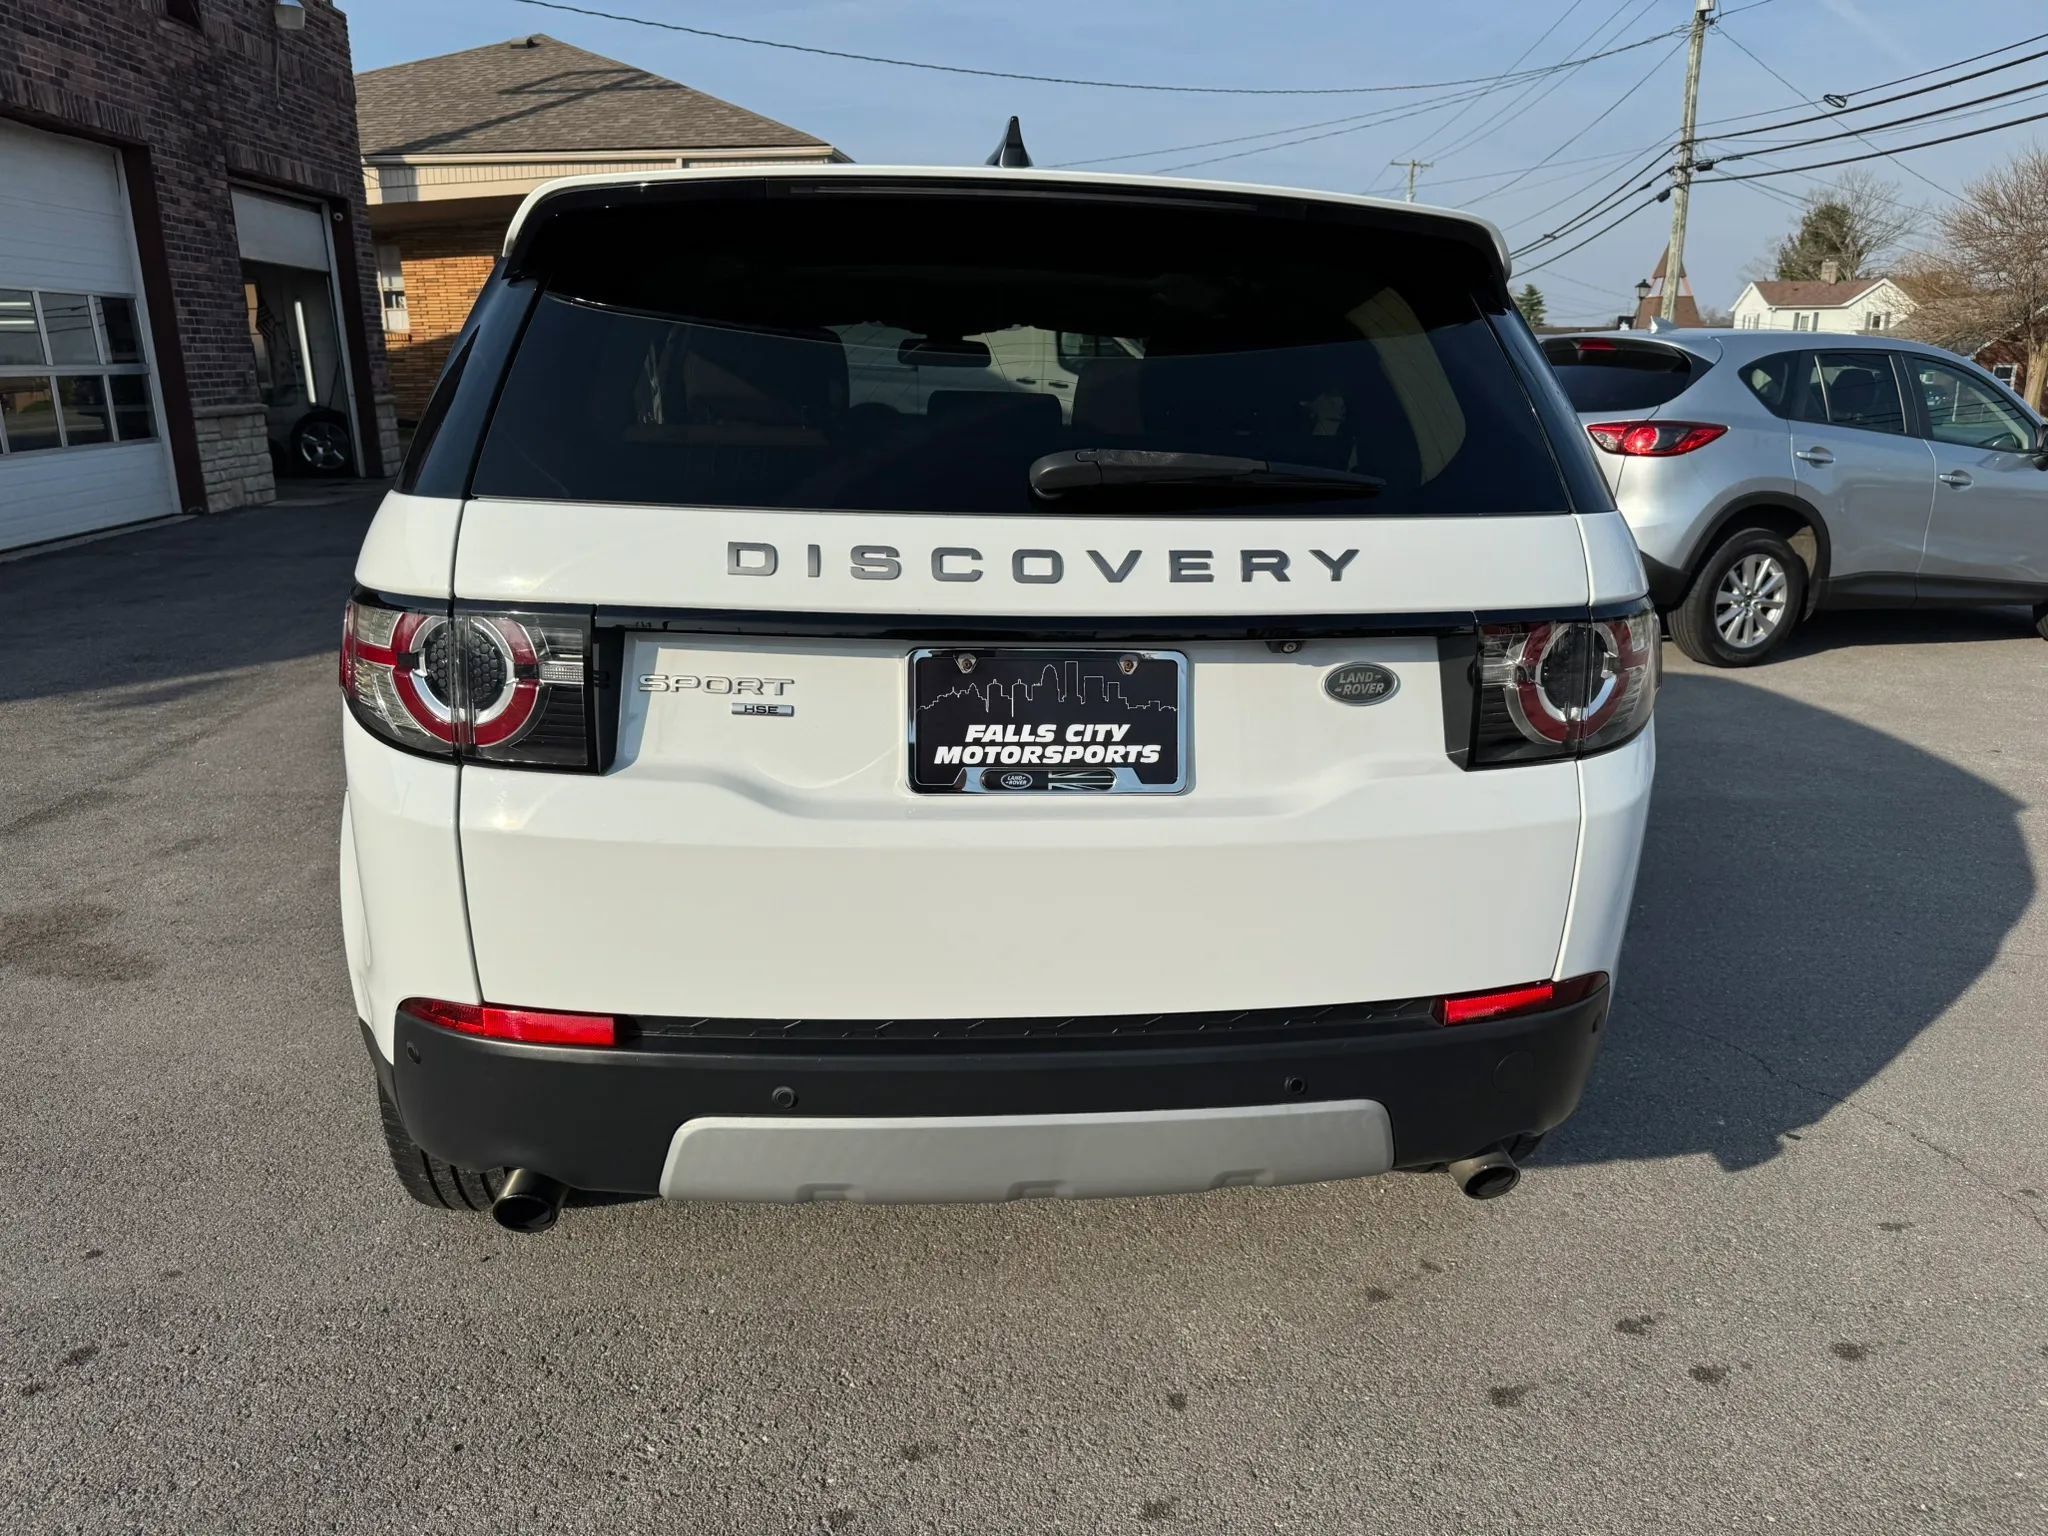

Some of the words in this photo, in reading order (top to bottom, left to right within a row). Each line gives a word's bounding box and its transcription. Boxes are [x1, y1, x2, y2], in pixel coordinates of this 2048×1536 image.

[727, 541, 1361, 585] DISCOVERY
[639, 674, 795, 696] SPORT
[744, 704, 779, 714] HSE
[965, 724, 1056, 743] FALLS
[1065, 724, 1130, 743] CITY
[934, 745, 1161, 764] MOTORSPORTS
